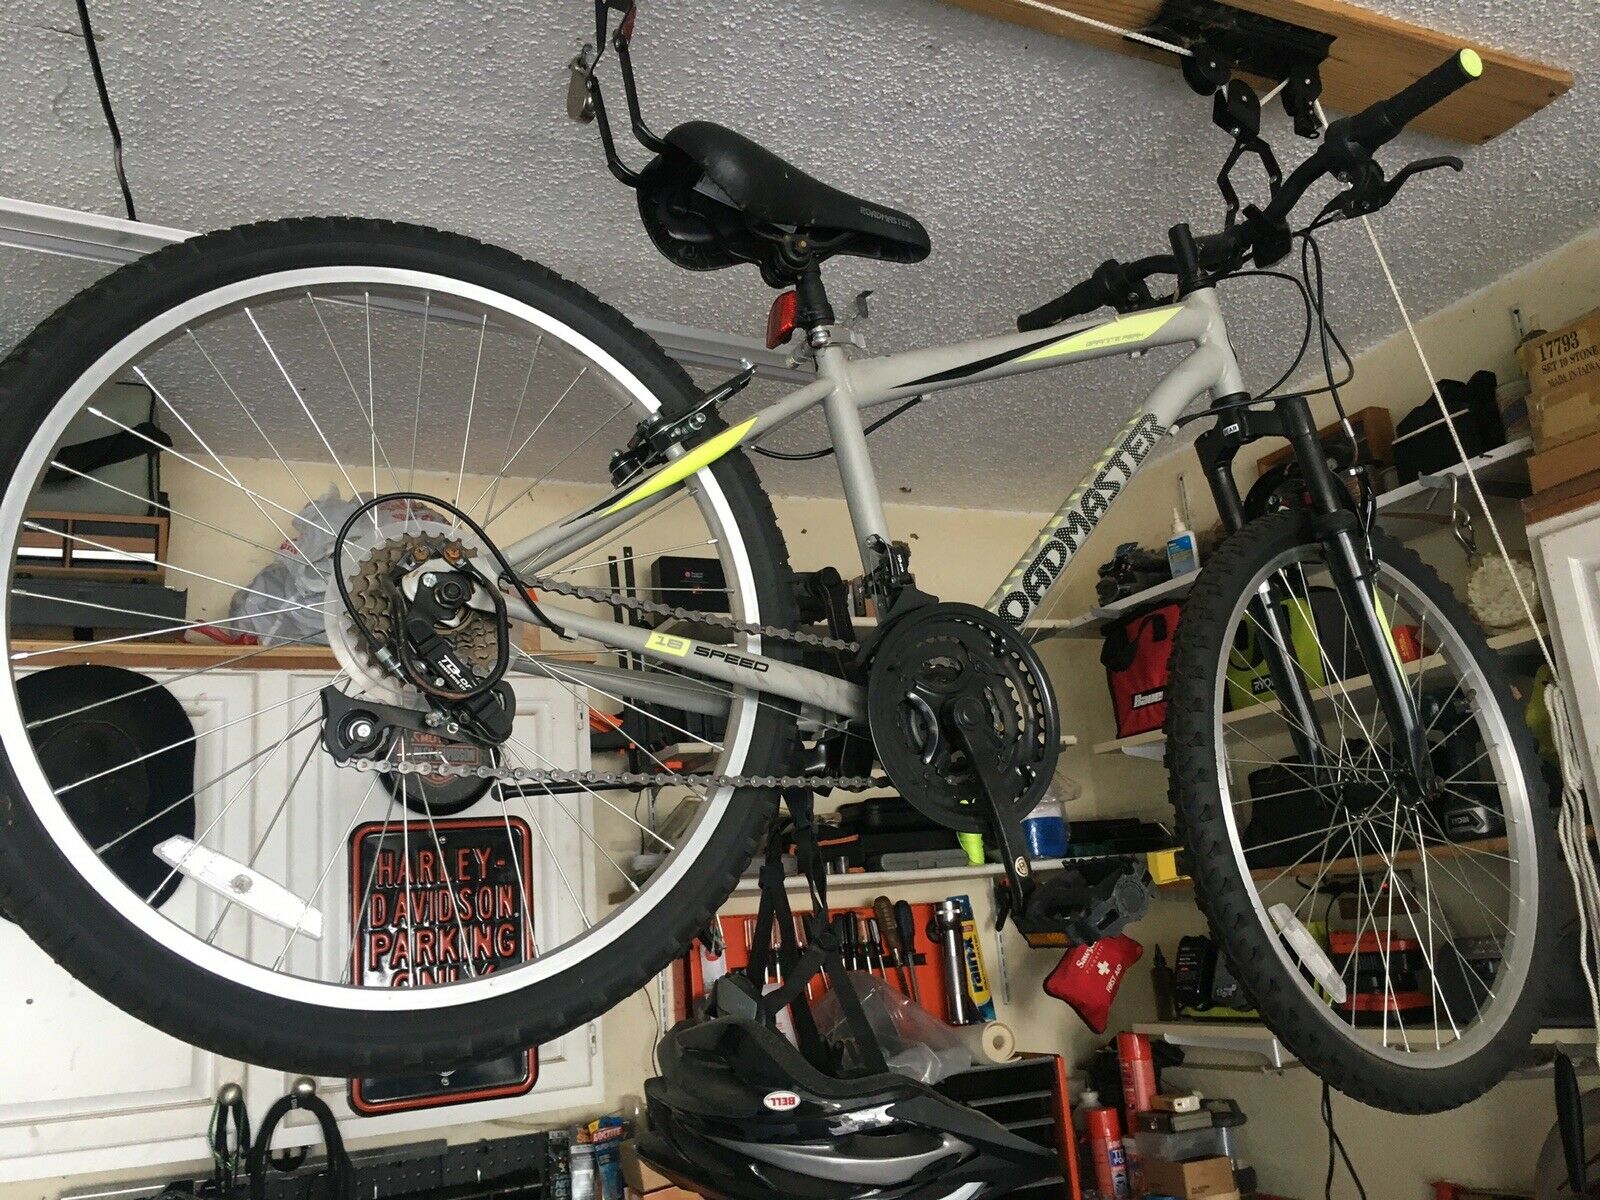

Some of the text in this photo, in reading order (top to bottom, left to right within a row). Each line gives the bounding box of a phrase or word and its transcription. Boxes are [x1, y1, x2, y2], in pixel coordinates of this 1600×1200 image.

[1537, 331, 1579, 361] 17793
[998, 412, 1166, 627] OADMASTER
[655, 635, 769, 673] 18 SPEED
[377, 847, 506, 886] HARLEY-
[370, 884, 514, 928] DAVIDSON
[369, 923, 515, 971] PARKING
[1105, 963, 1122, 993] FIRST AID
[770, 1096, 795, 1106] BELL
